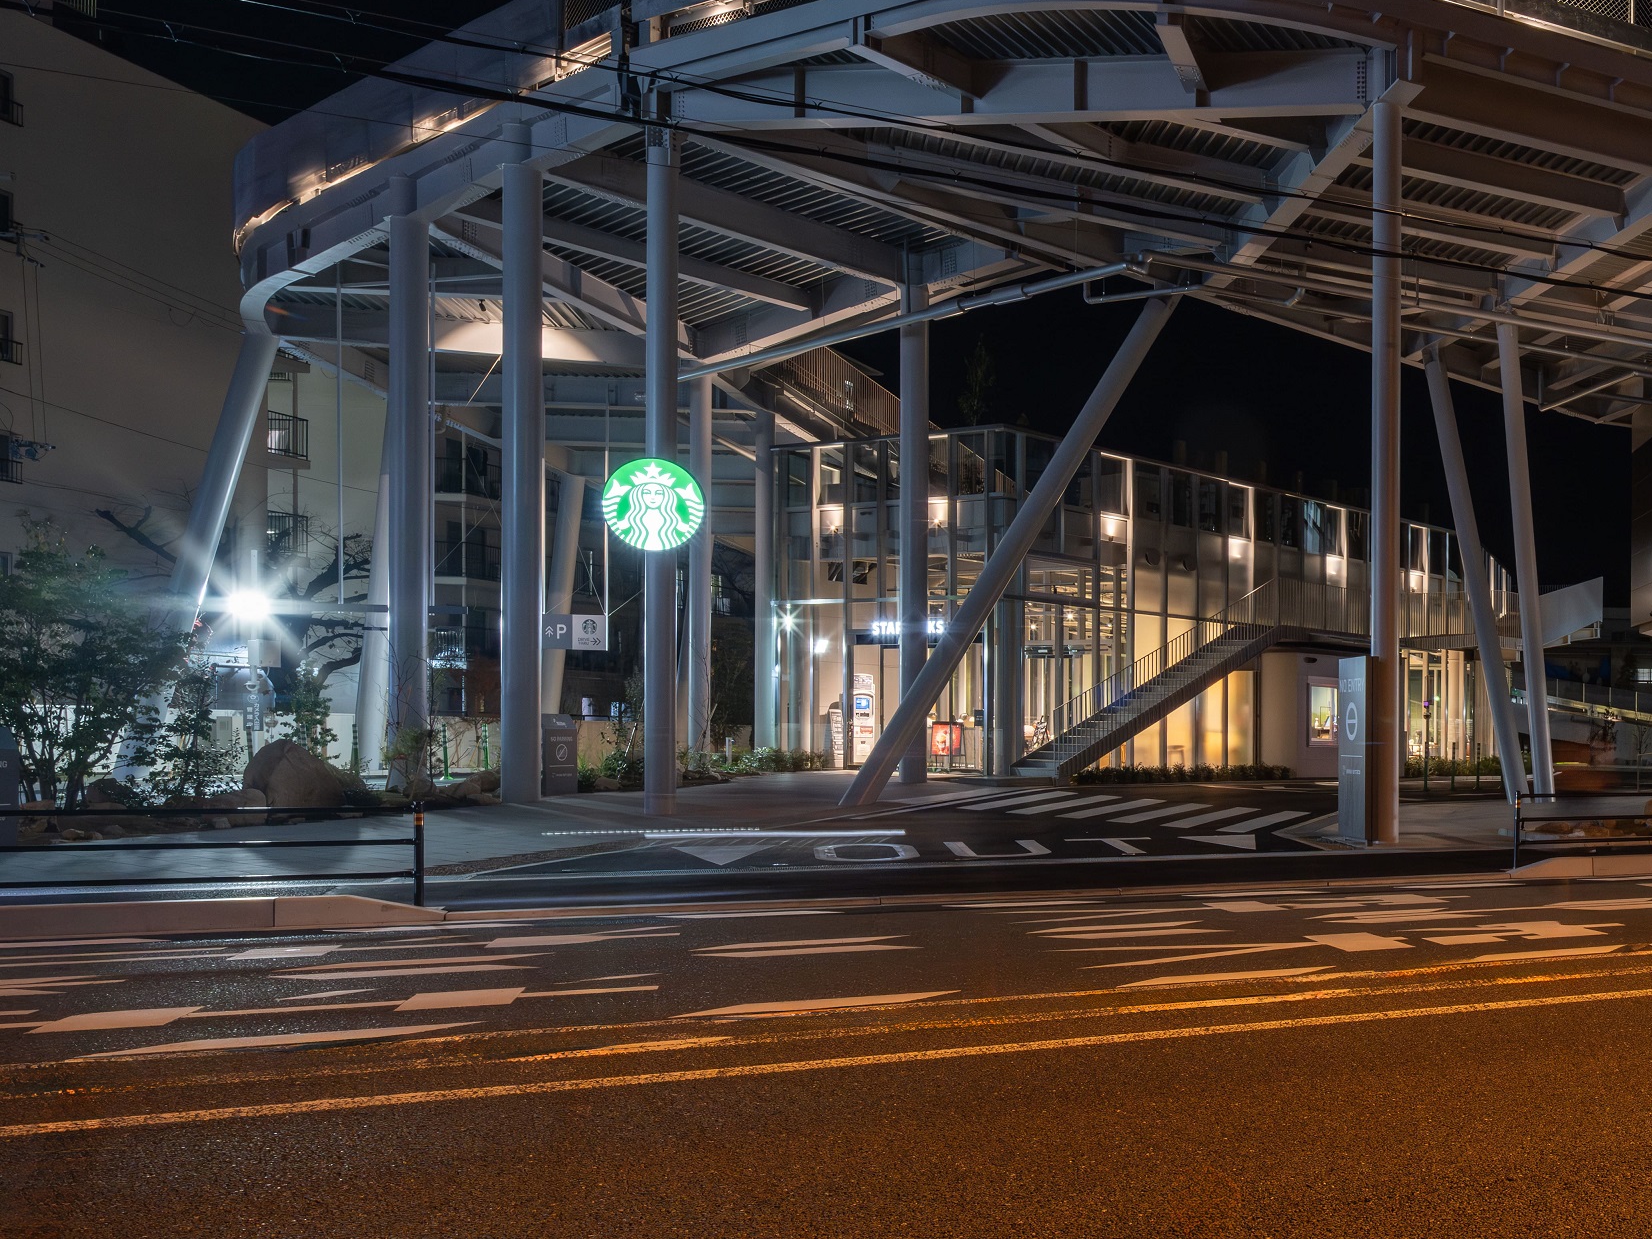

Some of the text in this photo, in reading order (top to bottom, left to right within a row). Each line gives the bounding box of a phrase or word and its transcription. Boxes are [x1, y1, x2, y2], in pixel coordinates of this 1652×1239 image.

[557, 623, 567, 639] P
[872, 621, 944, 635] STARKS
[1348, 677, 1365, 693] ENTRY
[813, 837, 1152, 861] OUT
